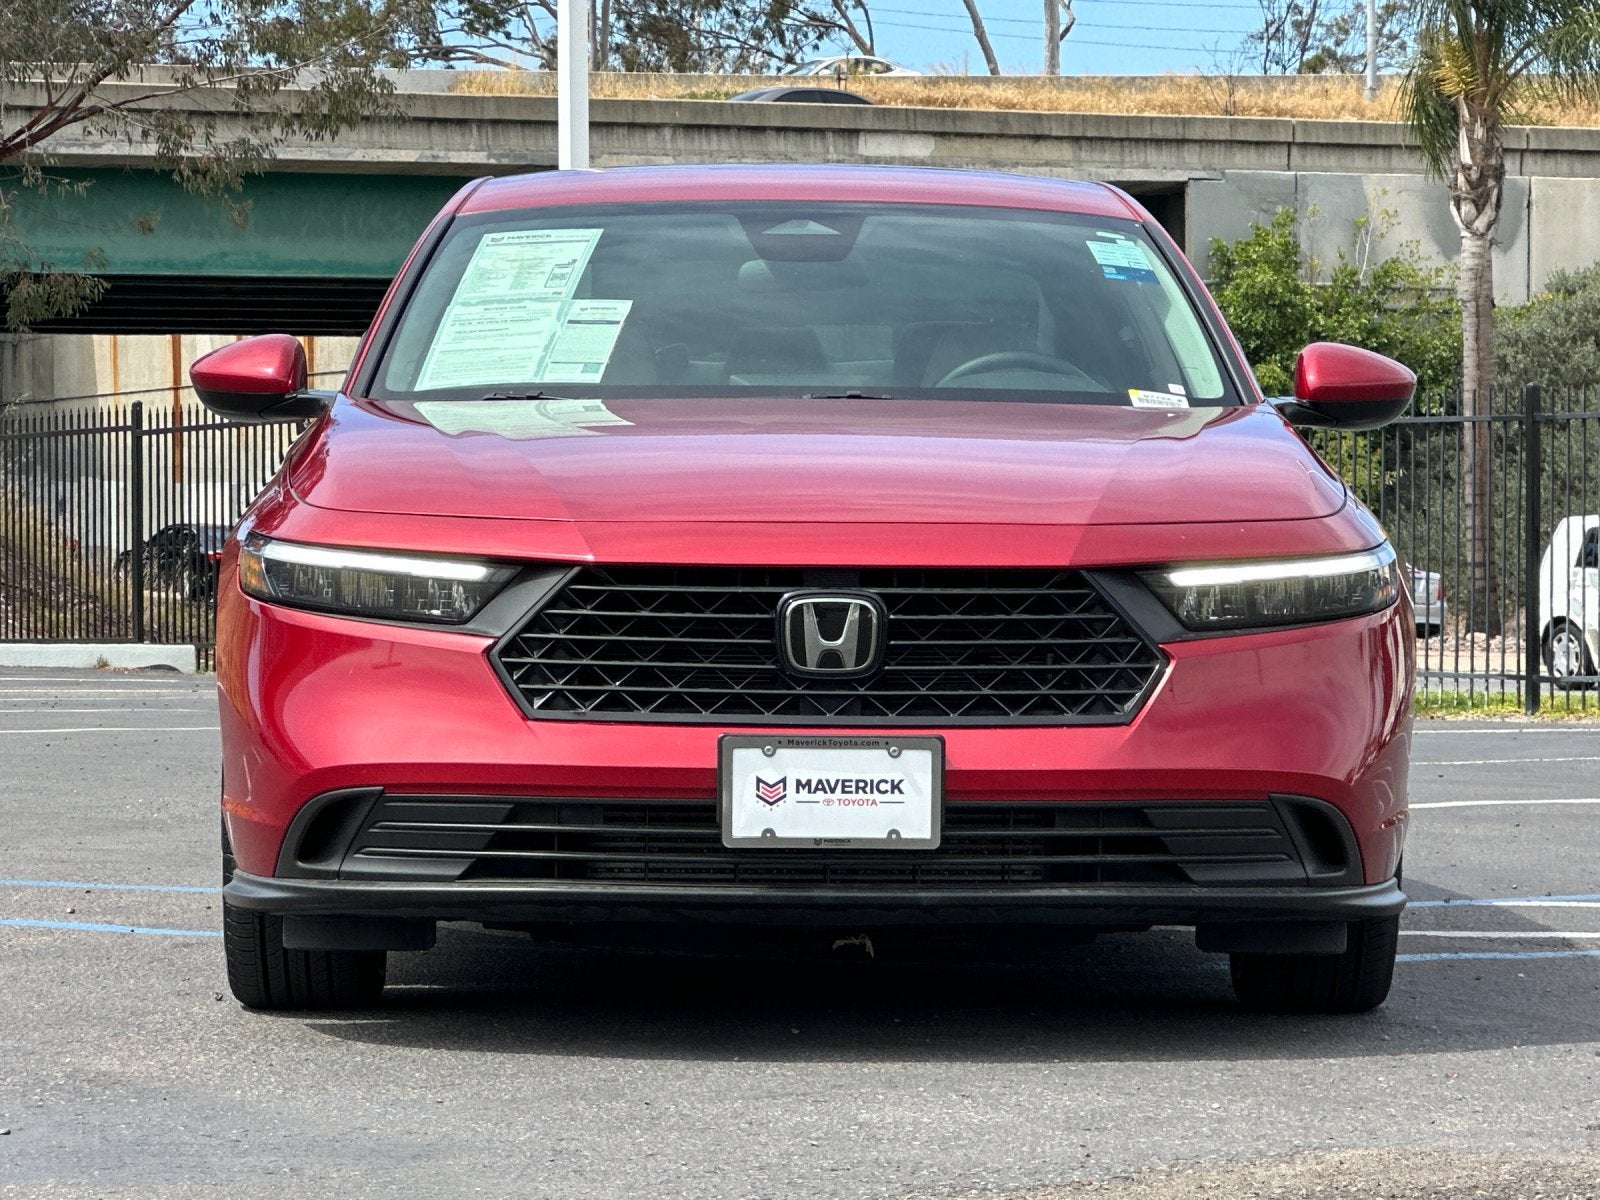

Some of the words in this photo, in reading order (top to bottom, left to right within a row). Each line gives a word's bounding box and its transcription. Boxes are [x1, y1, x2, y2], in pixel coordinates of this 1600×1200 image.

[787, 739, 880, 747] MaverickToyota.com
[795, 778, 905, 795] MAVERICK
[836, 798, 878, 807] TOYOTA
